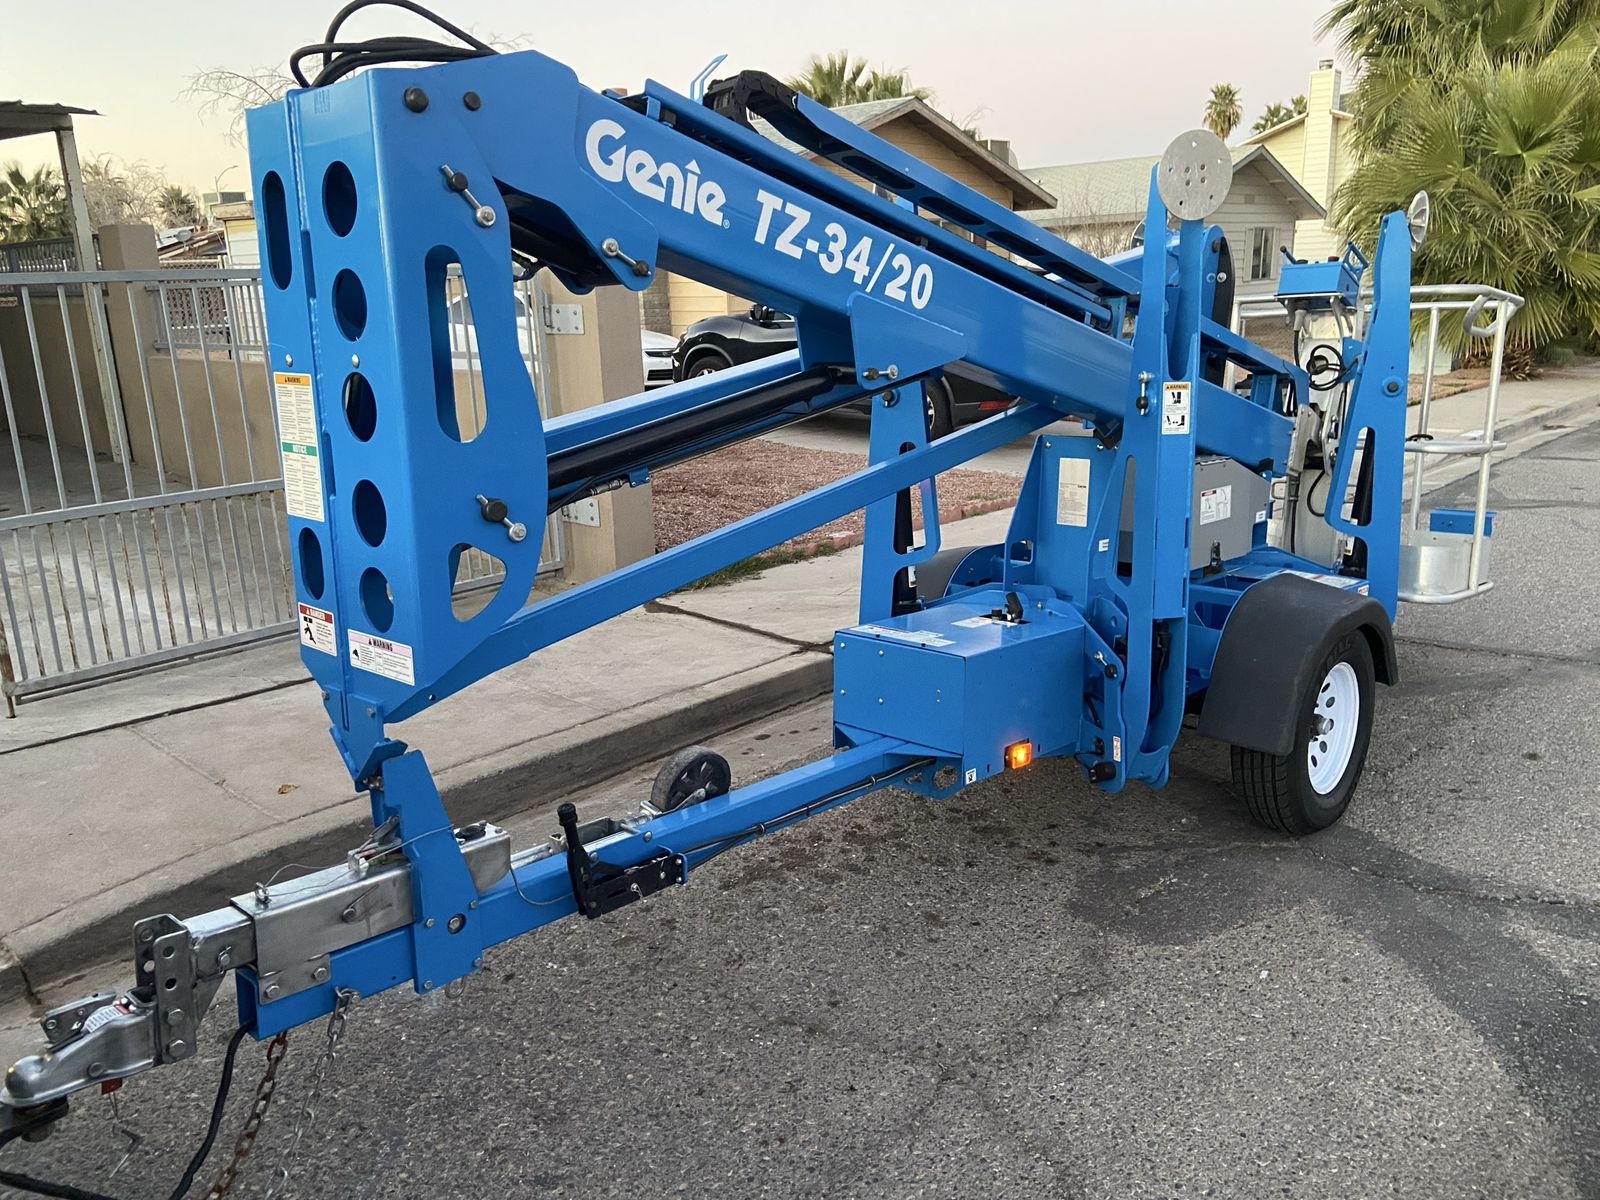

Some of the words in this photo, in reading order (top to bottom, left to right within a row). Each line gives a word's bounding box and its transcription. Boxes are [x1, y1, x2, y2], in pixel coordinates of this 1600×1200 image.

[585, 118, 727, 228] Genie
[753, 189, 934, 310] TZ-34/20
[373, 639, 393, 652] WARNING
